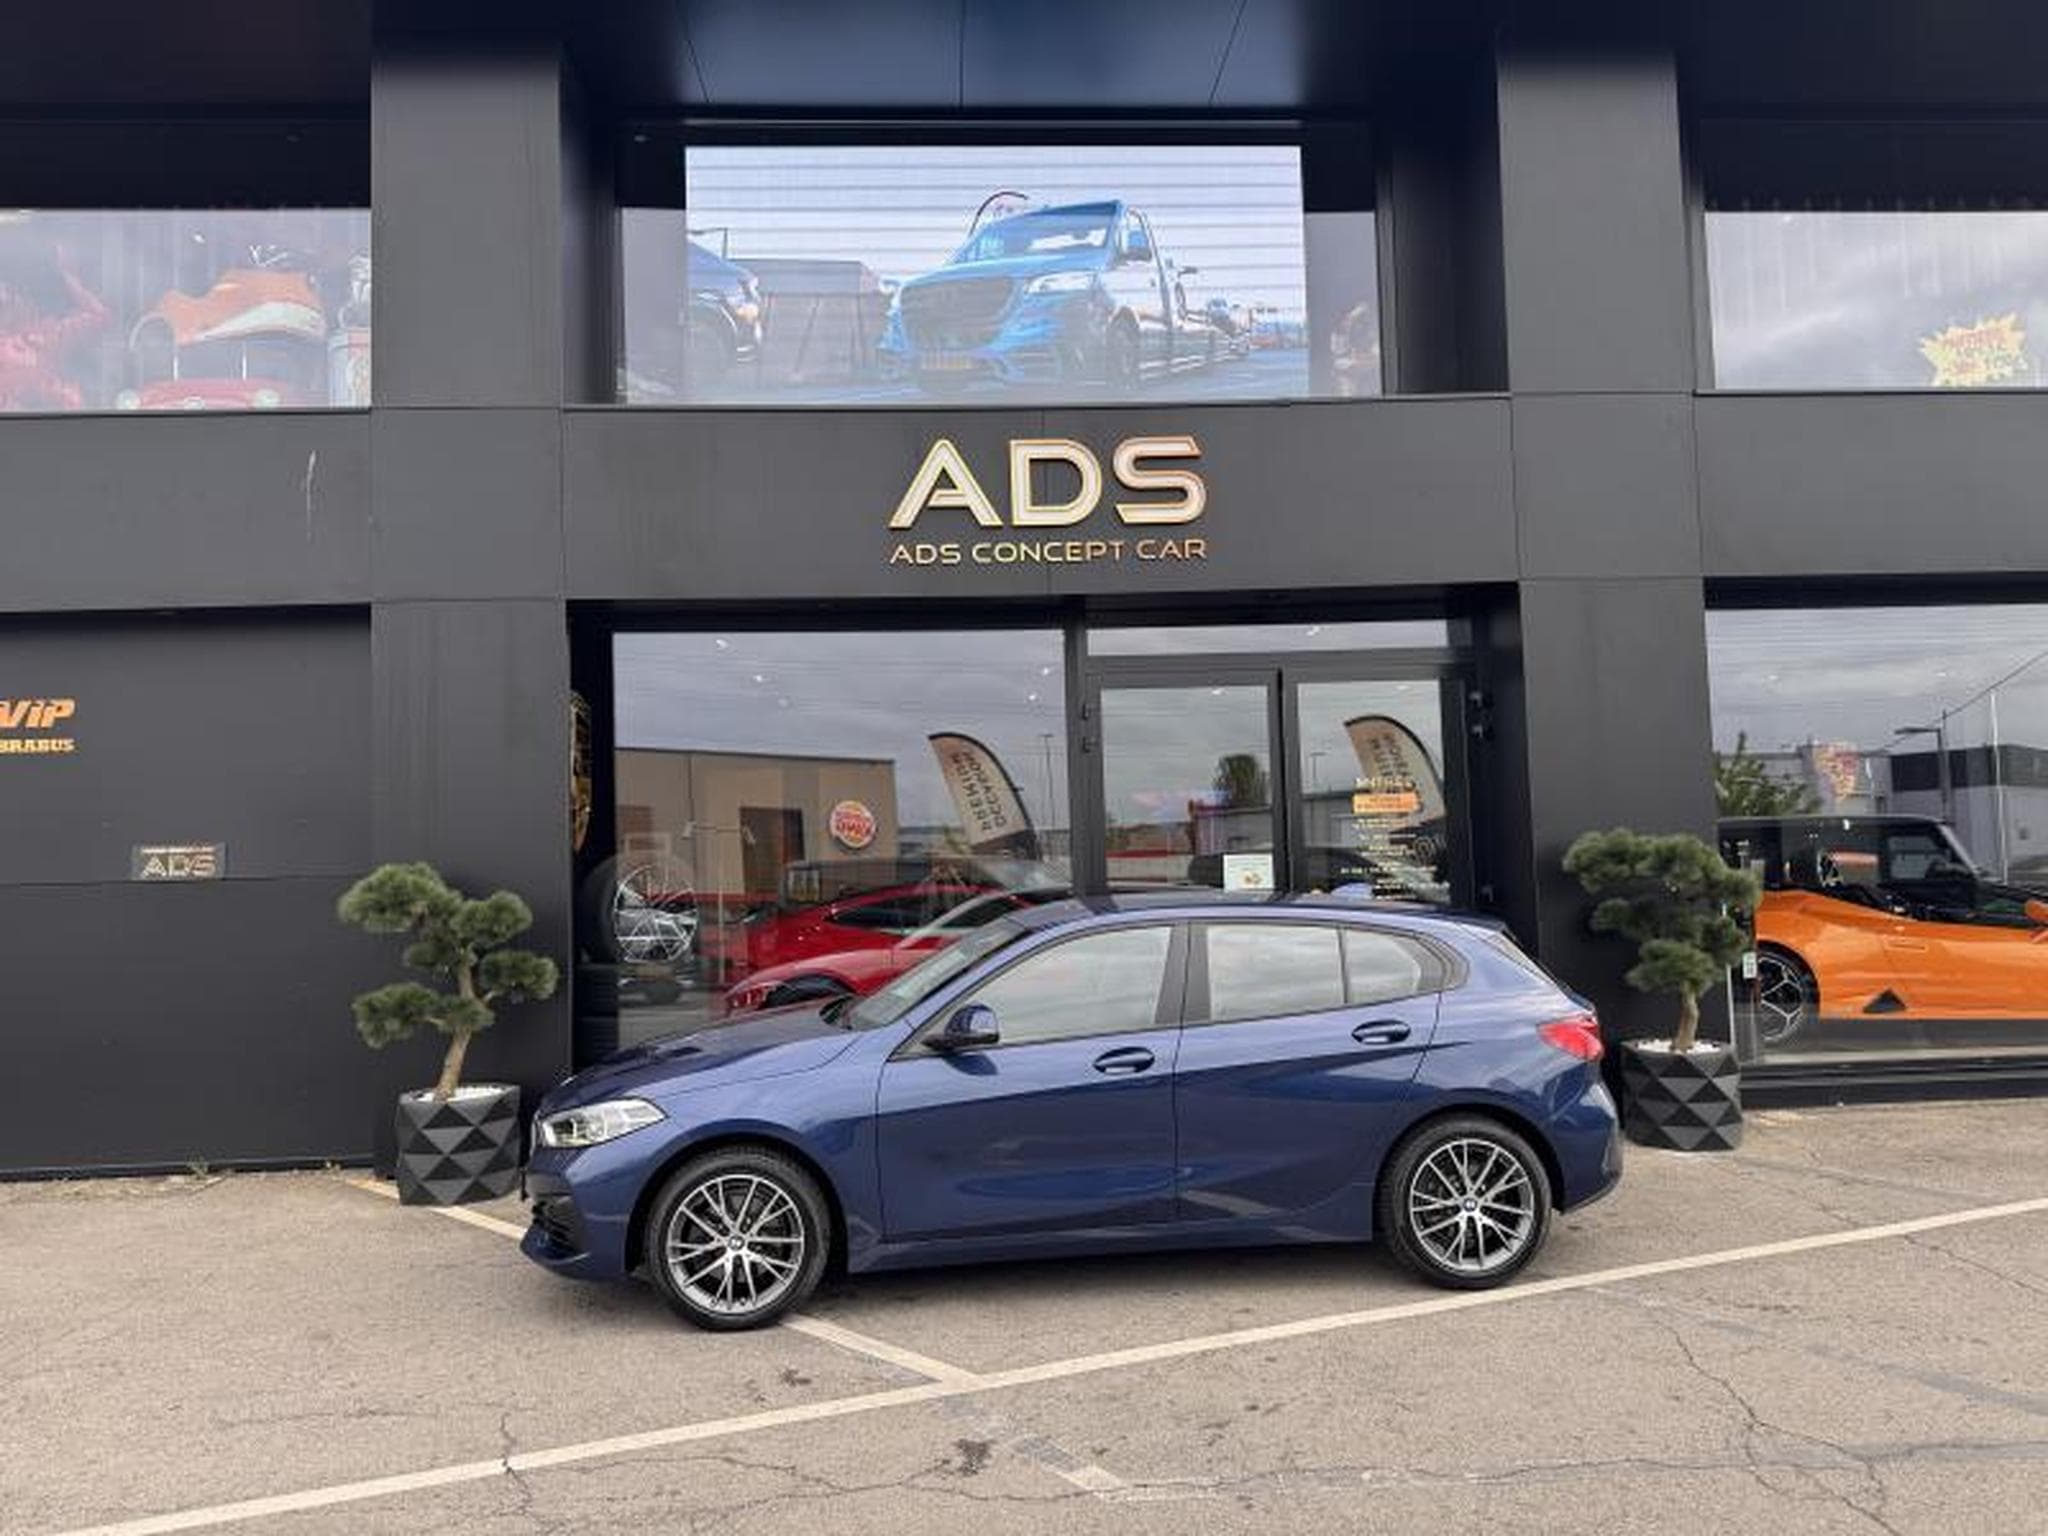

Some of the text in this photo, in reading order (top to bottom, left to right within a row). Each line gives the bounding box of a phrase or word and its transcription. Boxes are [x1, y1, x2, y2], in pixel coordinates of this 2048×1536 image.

[888, 436, 1207, 528] ADS
[889, 538, 1207, 566] ADS CONCEPT CAR
[140, 855, 216, 878] ADS
